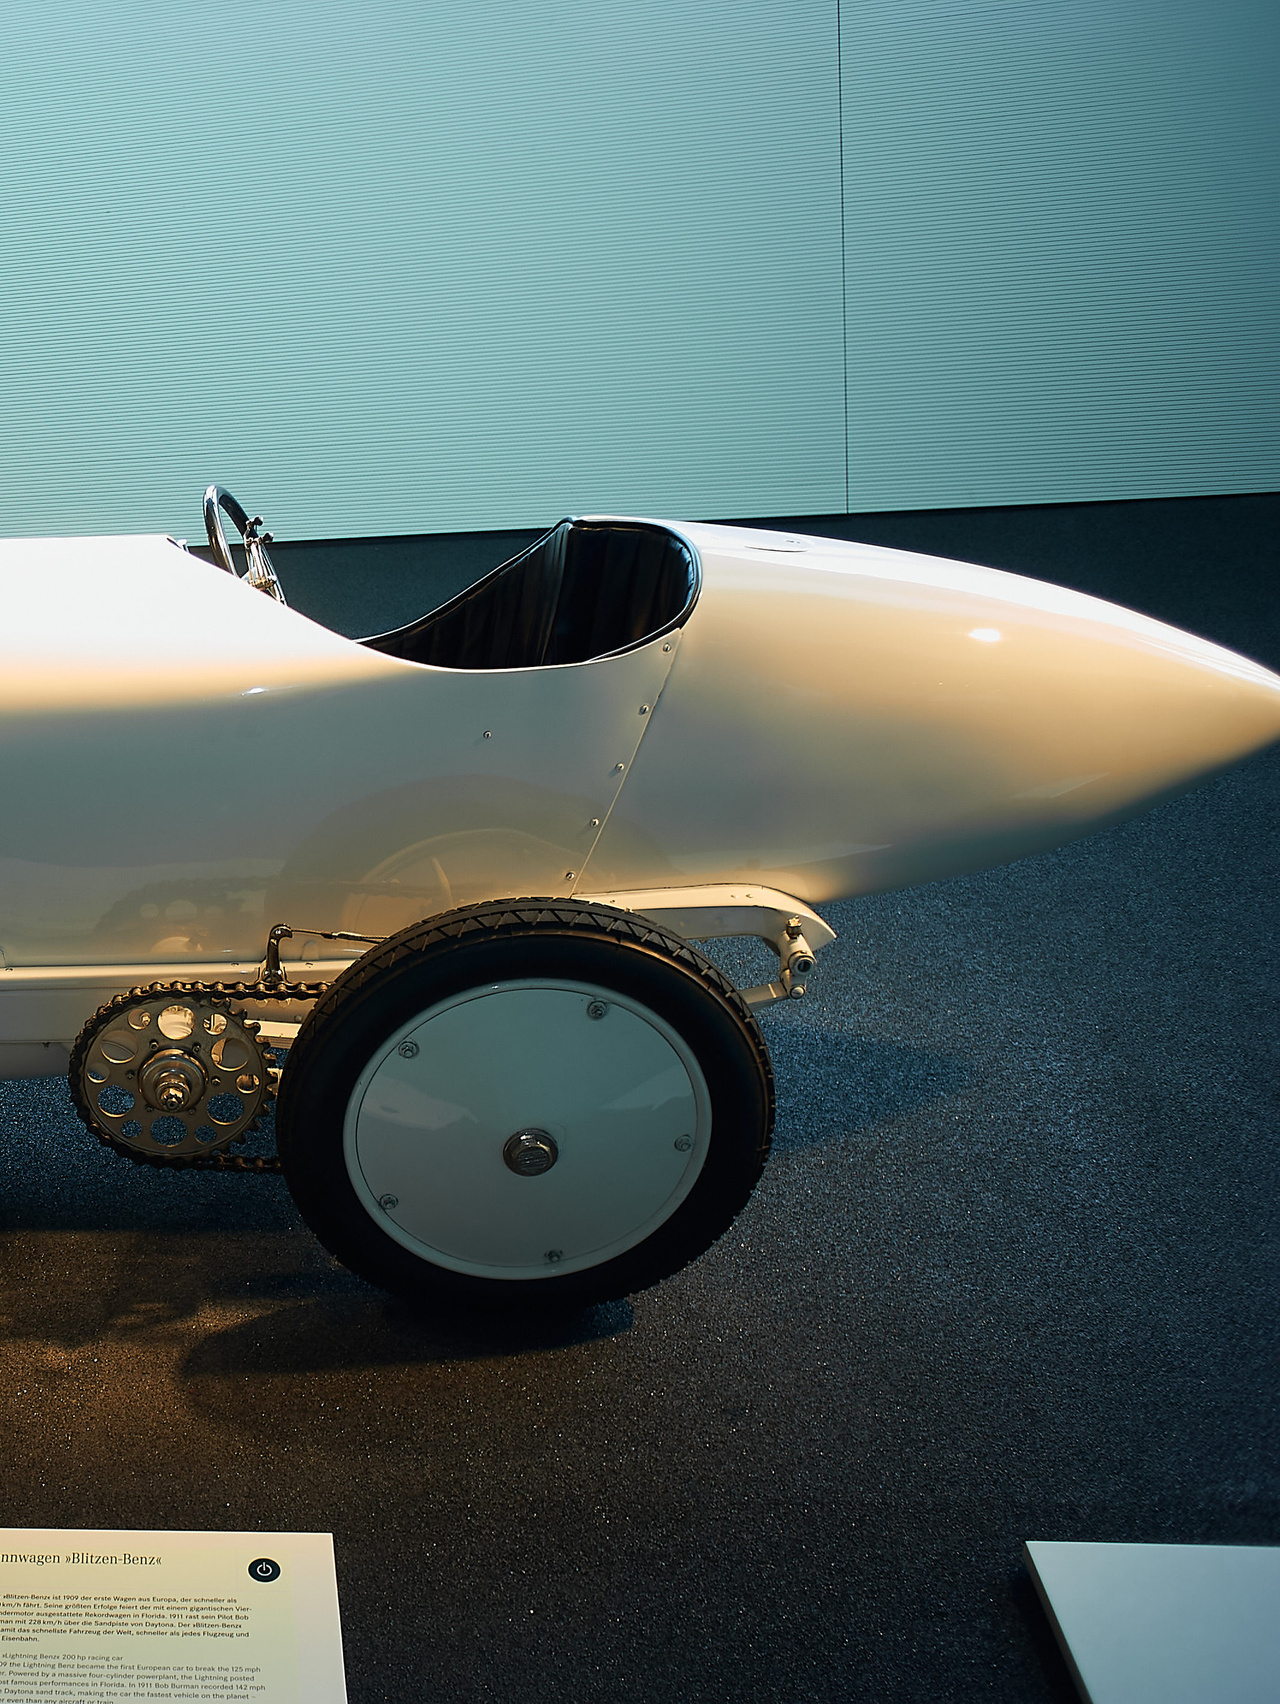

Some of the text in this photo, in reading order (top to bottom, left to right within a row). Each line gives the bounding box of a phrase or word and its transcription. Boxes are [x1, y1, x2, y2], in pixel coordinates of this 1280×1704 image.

[65, 1551, 161, 1565] »Blitzen-Benz«
[93, 1603, 118, 1611] Erfolge
[145, 1621, 176, 1629] Daytona.
[69, 1628, 101, 1636] Fahrzeug
[202, 1630, 234, 1638] Flugzeug
[22, 1661, 56, 1670] Lightning
[137, 1664, 171, 1672] European
[244, 1666, 261, 1674] mph
[41, 1671, 50, 1679] by
[194, 1674, 229, 1682] Lightning
[39, 1680, 89, 1688] performances
[200, 1681, 234, 1690] recorded
[4, 1688, 34, 1696] Daytona
[54, 1687, 76, 1697] track,
[77, 1690, 105, 1698] making
